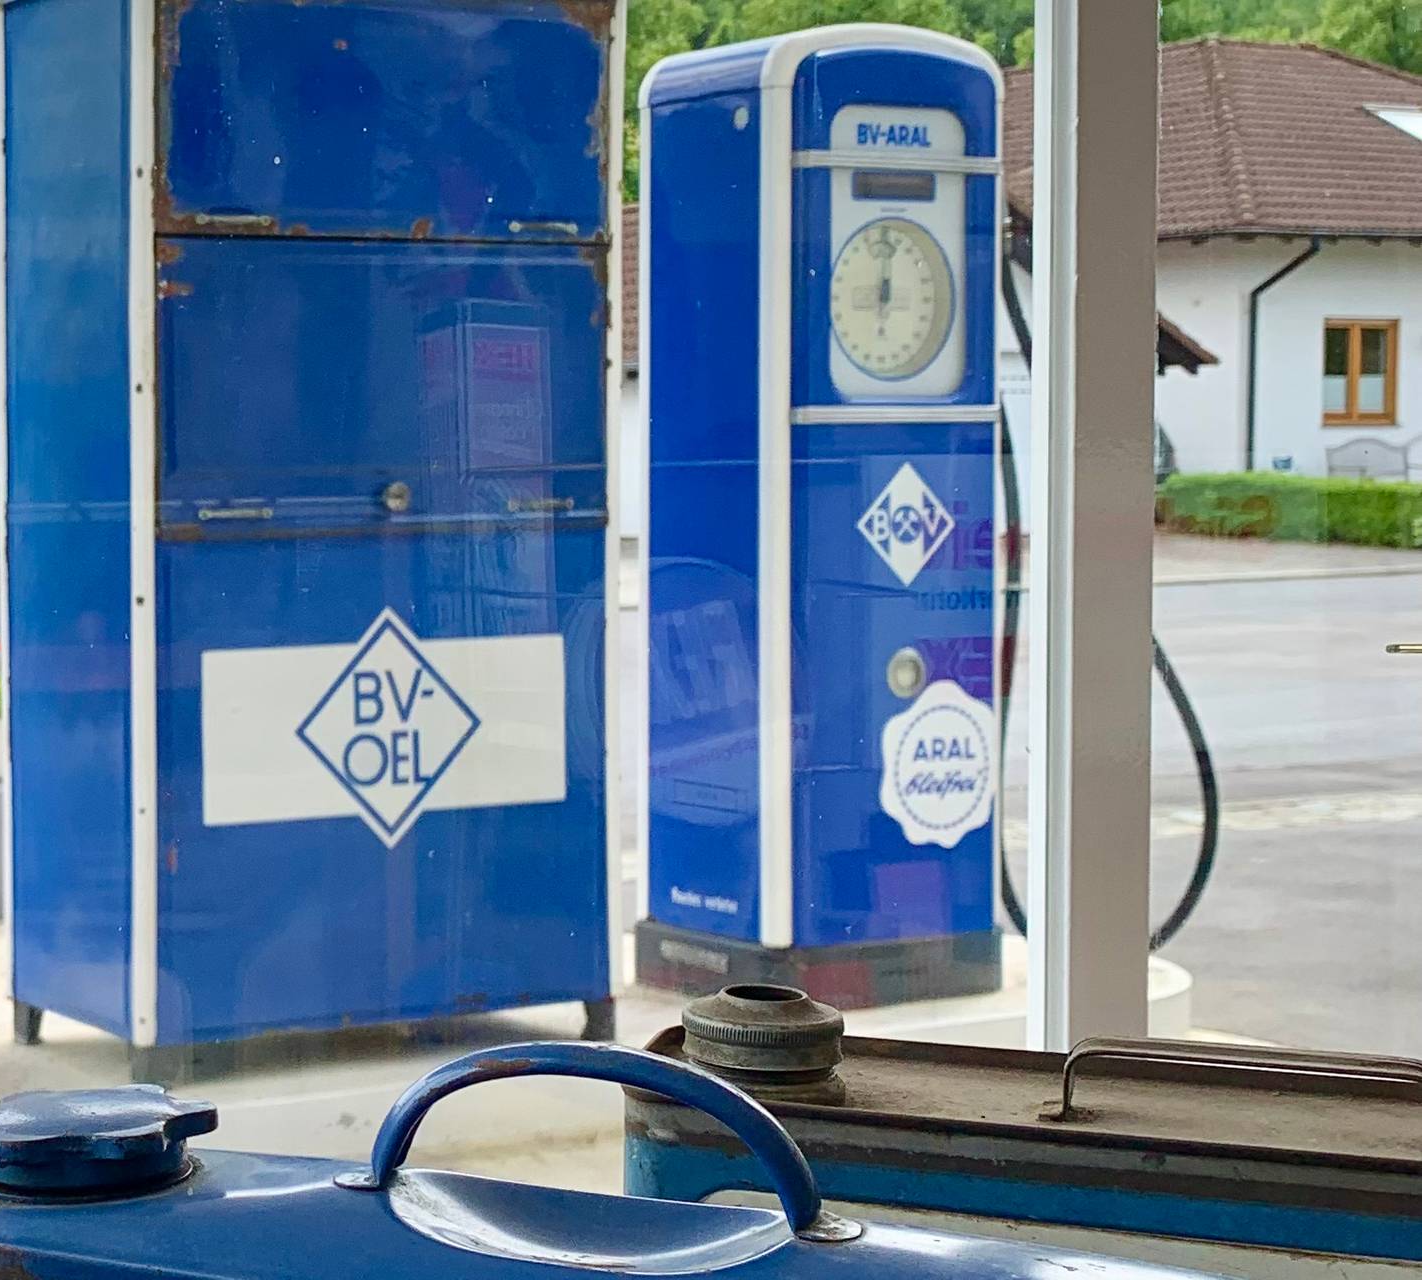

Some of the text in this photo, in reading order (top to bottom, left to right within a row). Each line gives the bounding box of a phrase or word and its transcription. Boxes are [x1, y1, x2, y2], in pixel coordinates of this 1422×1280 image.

[857, 122, 932, 147] BV-ARAL
[353, 669, 434, 726] BV-
[343, 729, 434, 787] OEL
[914, 737, 976, 761] ARAL
[904, 769, 982, 800] bleifrei
